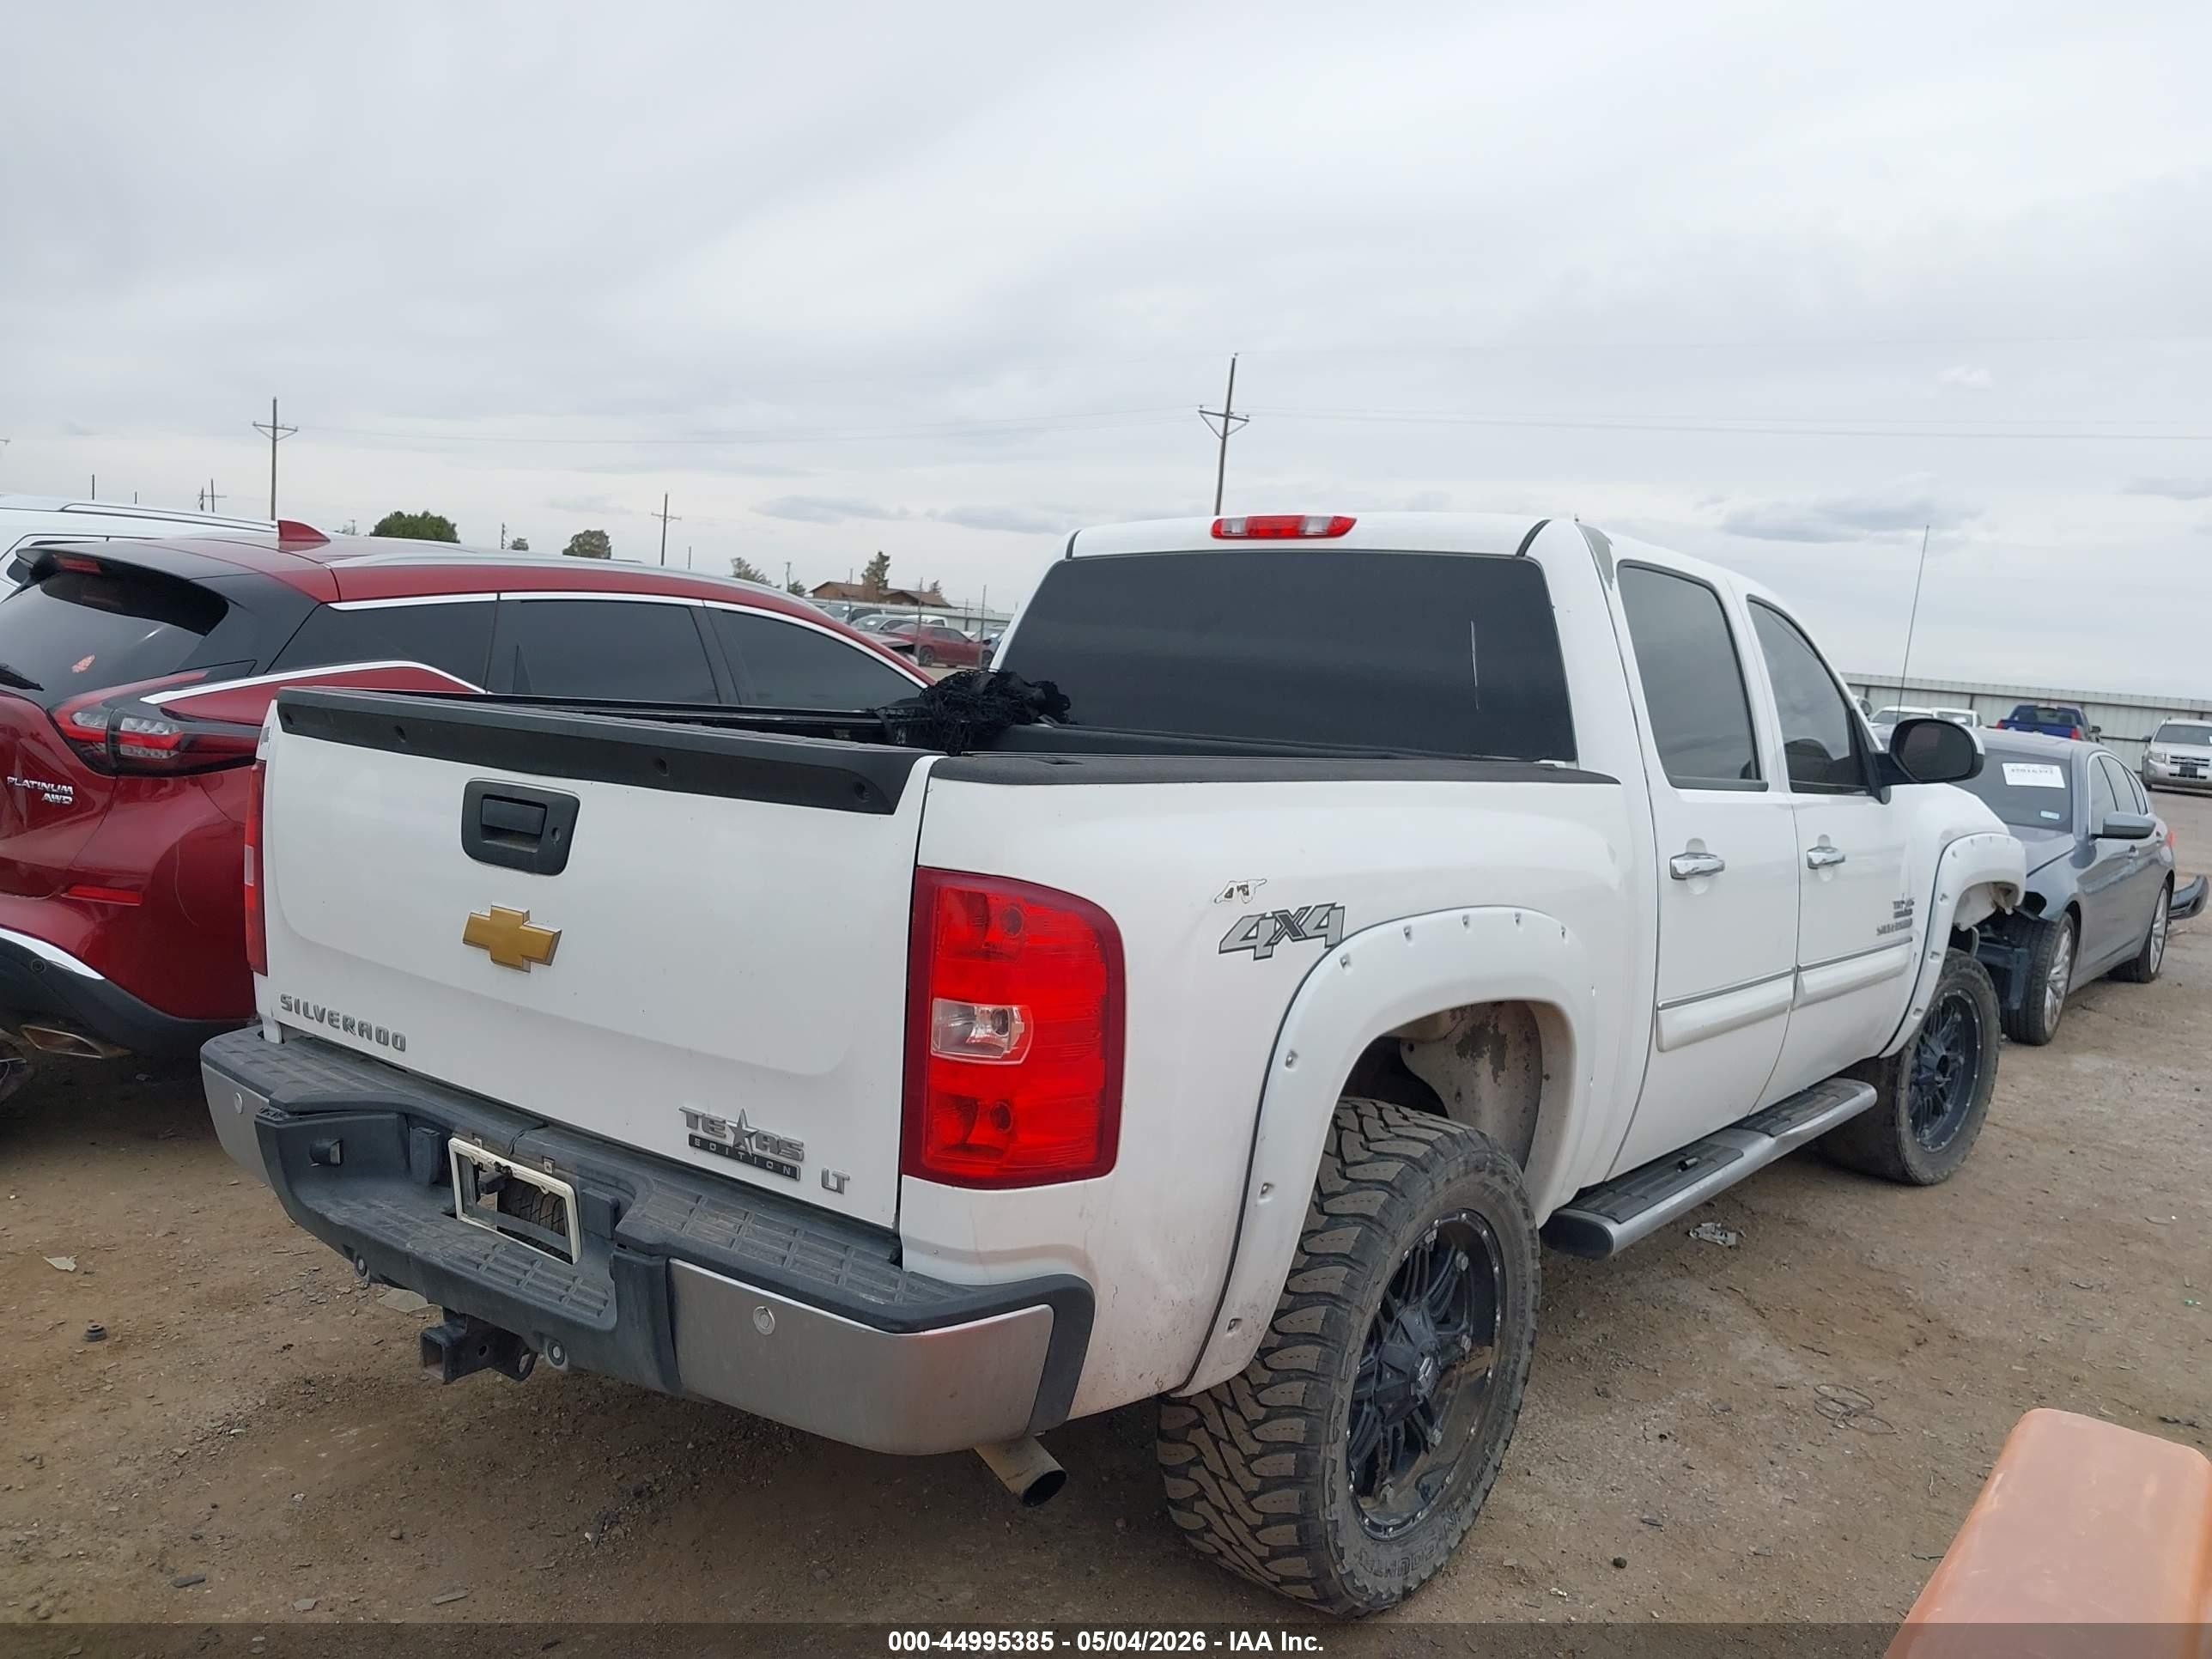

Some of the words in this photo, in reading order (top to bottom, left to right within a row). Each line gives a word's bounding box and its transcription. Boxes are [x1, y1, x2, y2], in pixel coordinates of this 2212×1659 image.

[7, 775, 74, 795] PLATINUM
[40, 792, 74, 805] AWD
[279, 993, 406, 1053] SILVERADO
[693, 1137, 792, 1176] EDITION
[820, 1166, 851, 1195] LT
